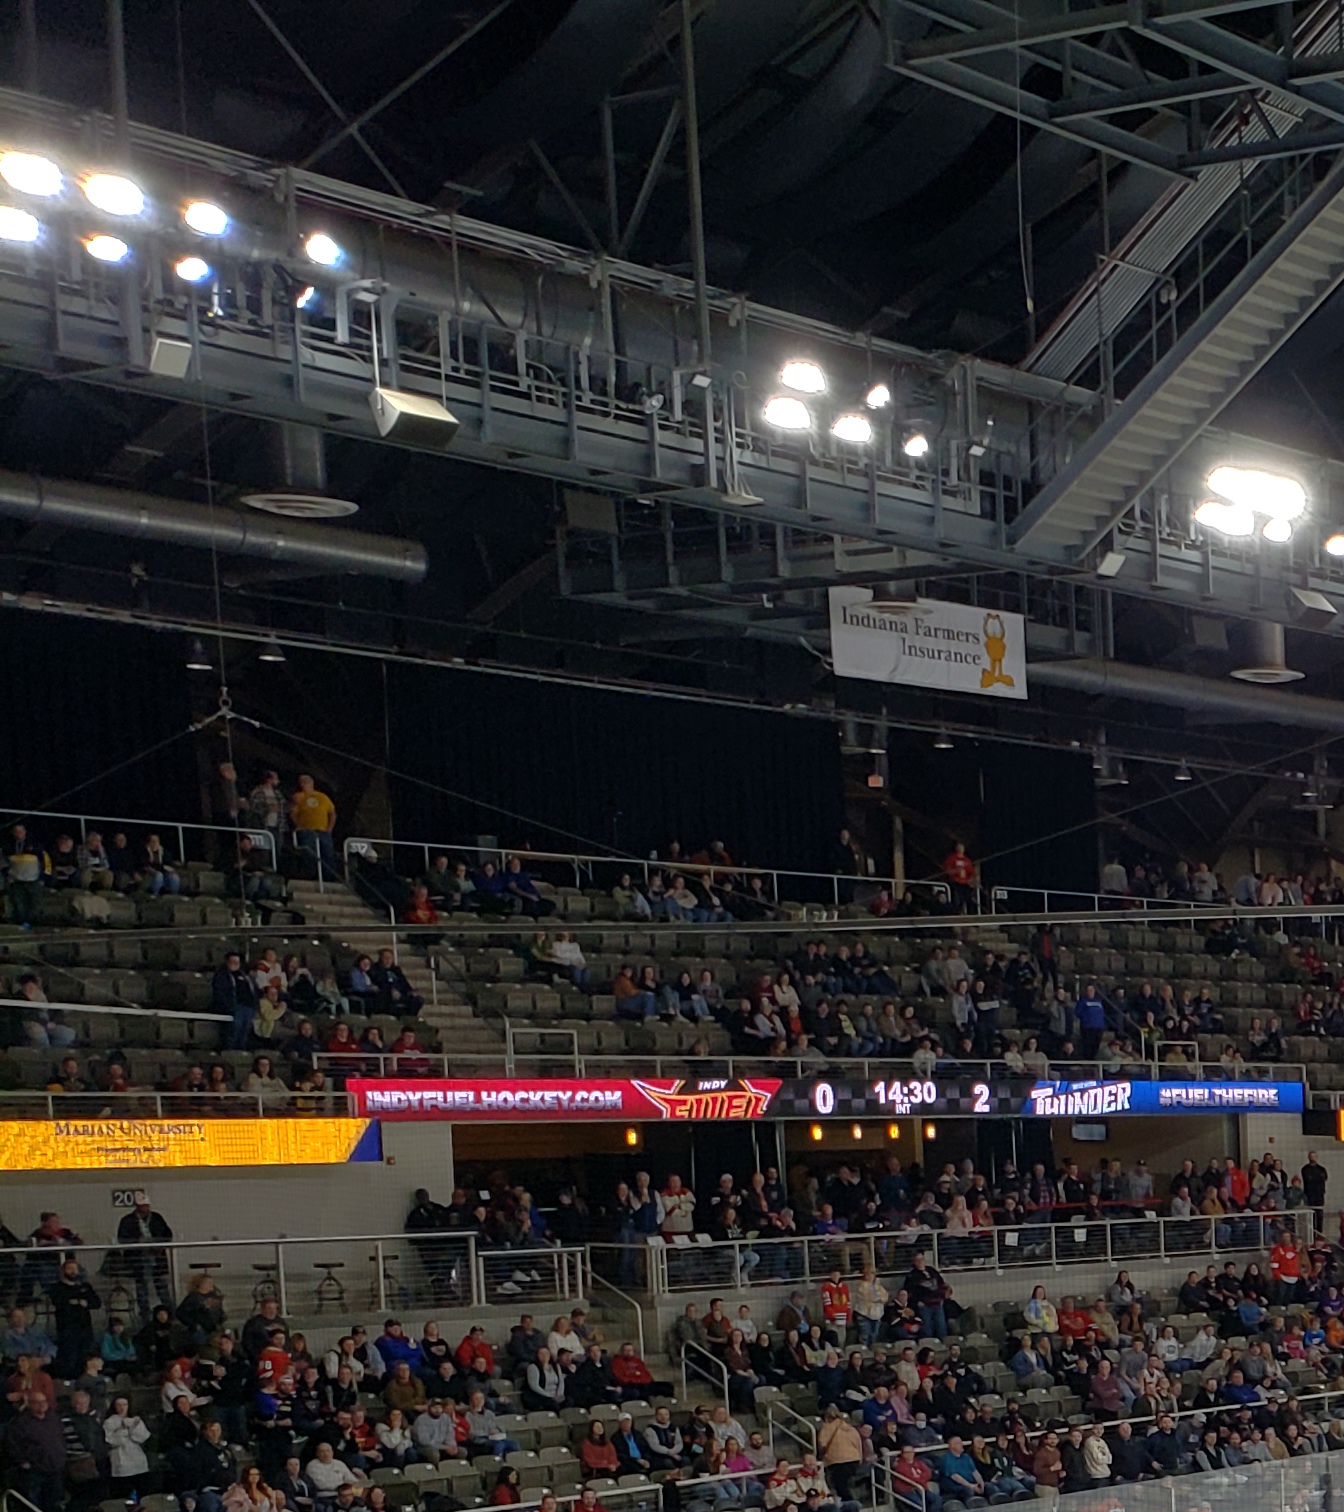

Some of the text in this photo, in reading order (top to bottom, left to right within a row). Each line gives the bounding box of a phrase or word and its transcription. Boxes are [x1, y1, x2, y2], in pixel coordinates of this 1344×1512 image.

[841, 606, 981, 645] Indiana Farmers
[901, 638, 982, 666] Insurance
[698, 1079, 728, 1090] INDY
[874, 1081, 937, 1105] 14:30
[366, 1090, 622, 1112] INDYFUELHOCKEY.COM
[815, 1083, 834, 1114] 0
[895, 1103, 912, 1115] INT
[973, 1085, 990, 1112] 2
[1031, 1082, 1132, 1115] THUNDER
[1159, 1088, 1279, 1108] #FUELTHEFIRE
[114, 1191, 144, 1207] 20
